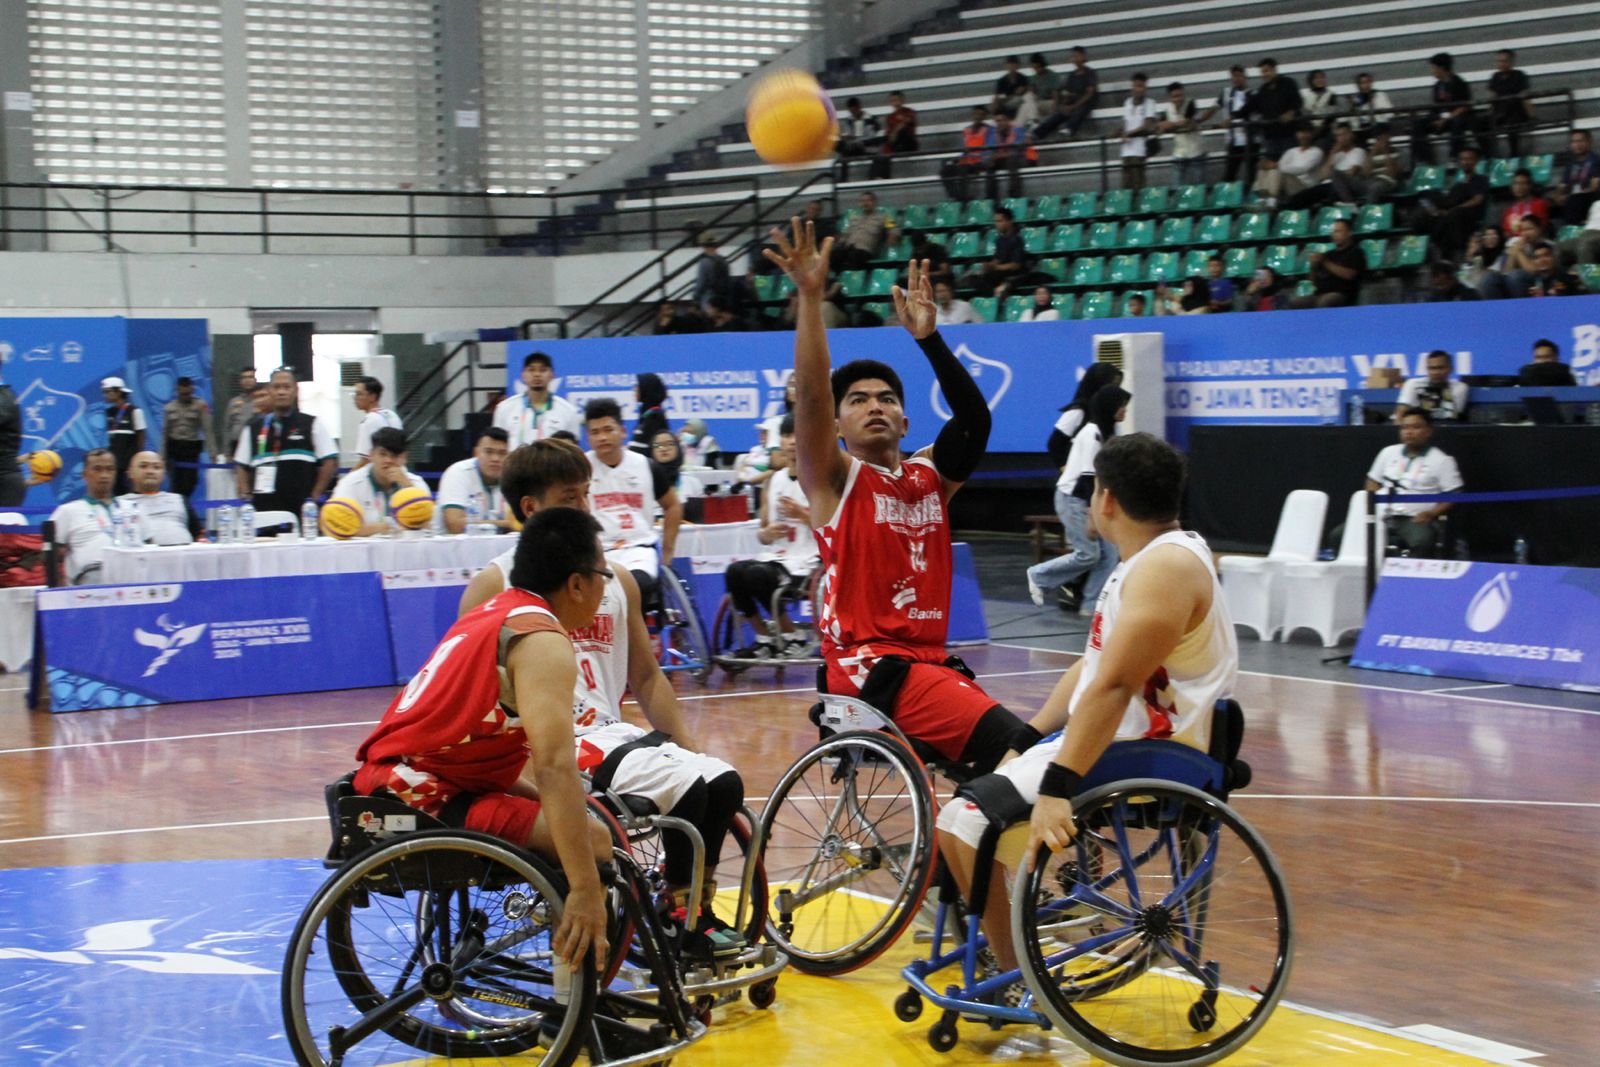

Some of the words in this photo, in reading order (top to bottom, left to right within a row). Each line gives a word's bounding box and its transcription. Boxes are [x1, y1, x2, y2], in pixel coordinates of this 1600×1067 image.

[1272, 356, 1347, 374] NASIONAL
[691, 371, 759, 385] NASIONAL
[682, 395, 751, 413] TENGAH
[1206, 387, 1254, 409] JAWA
[1259, 386, 1339, 409] TENGAH
[210, 626, 280, 640] PEPARNAS
[1376, 634, 1401, 647] PT
[1449, 640, 1550, 661] RESOURCES
